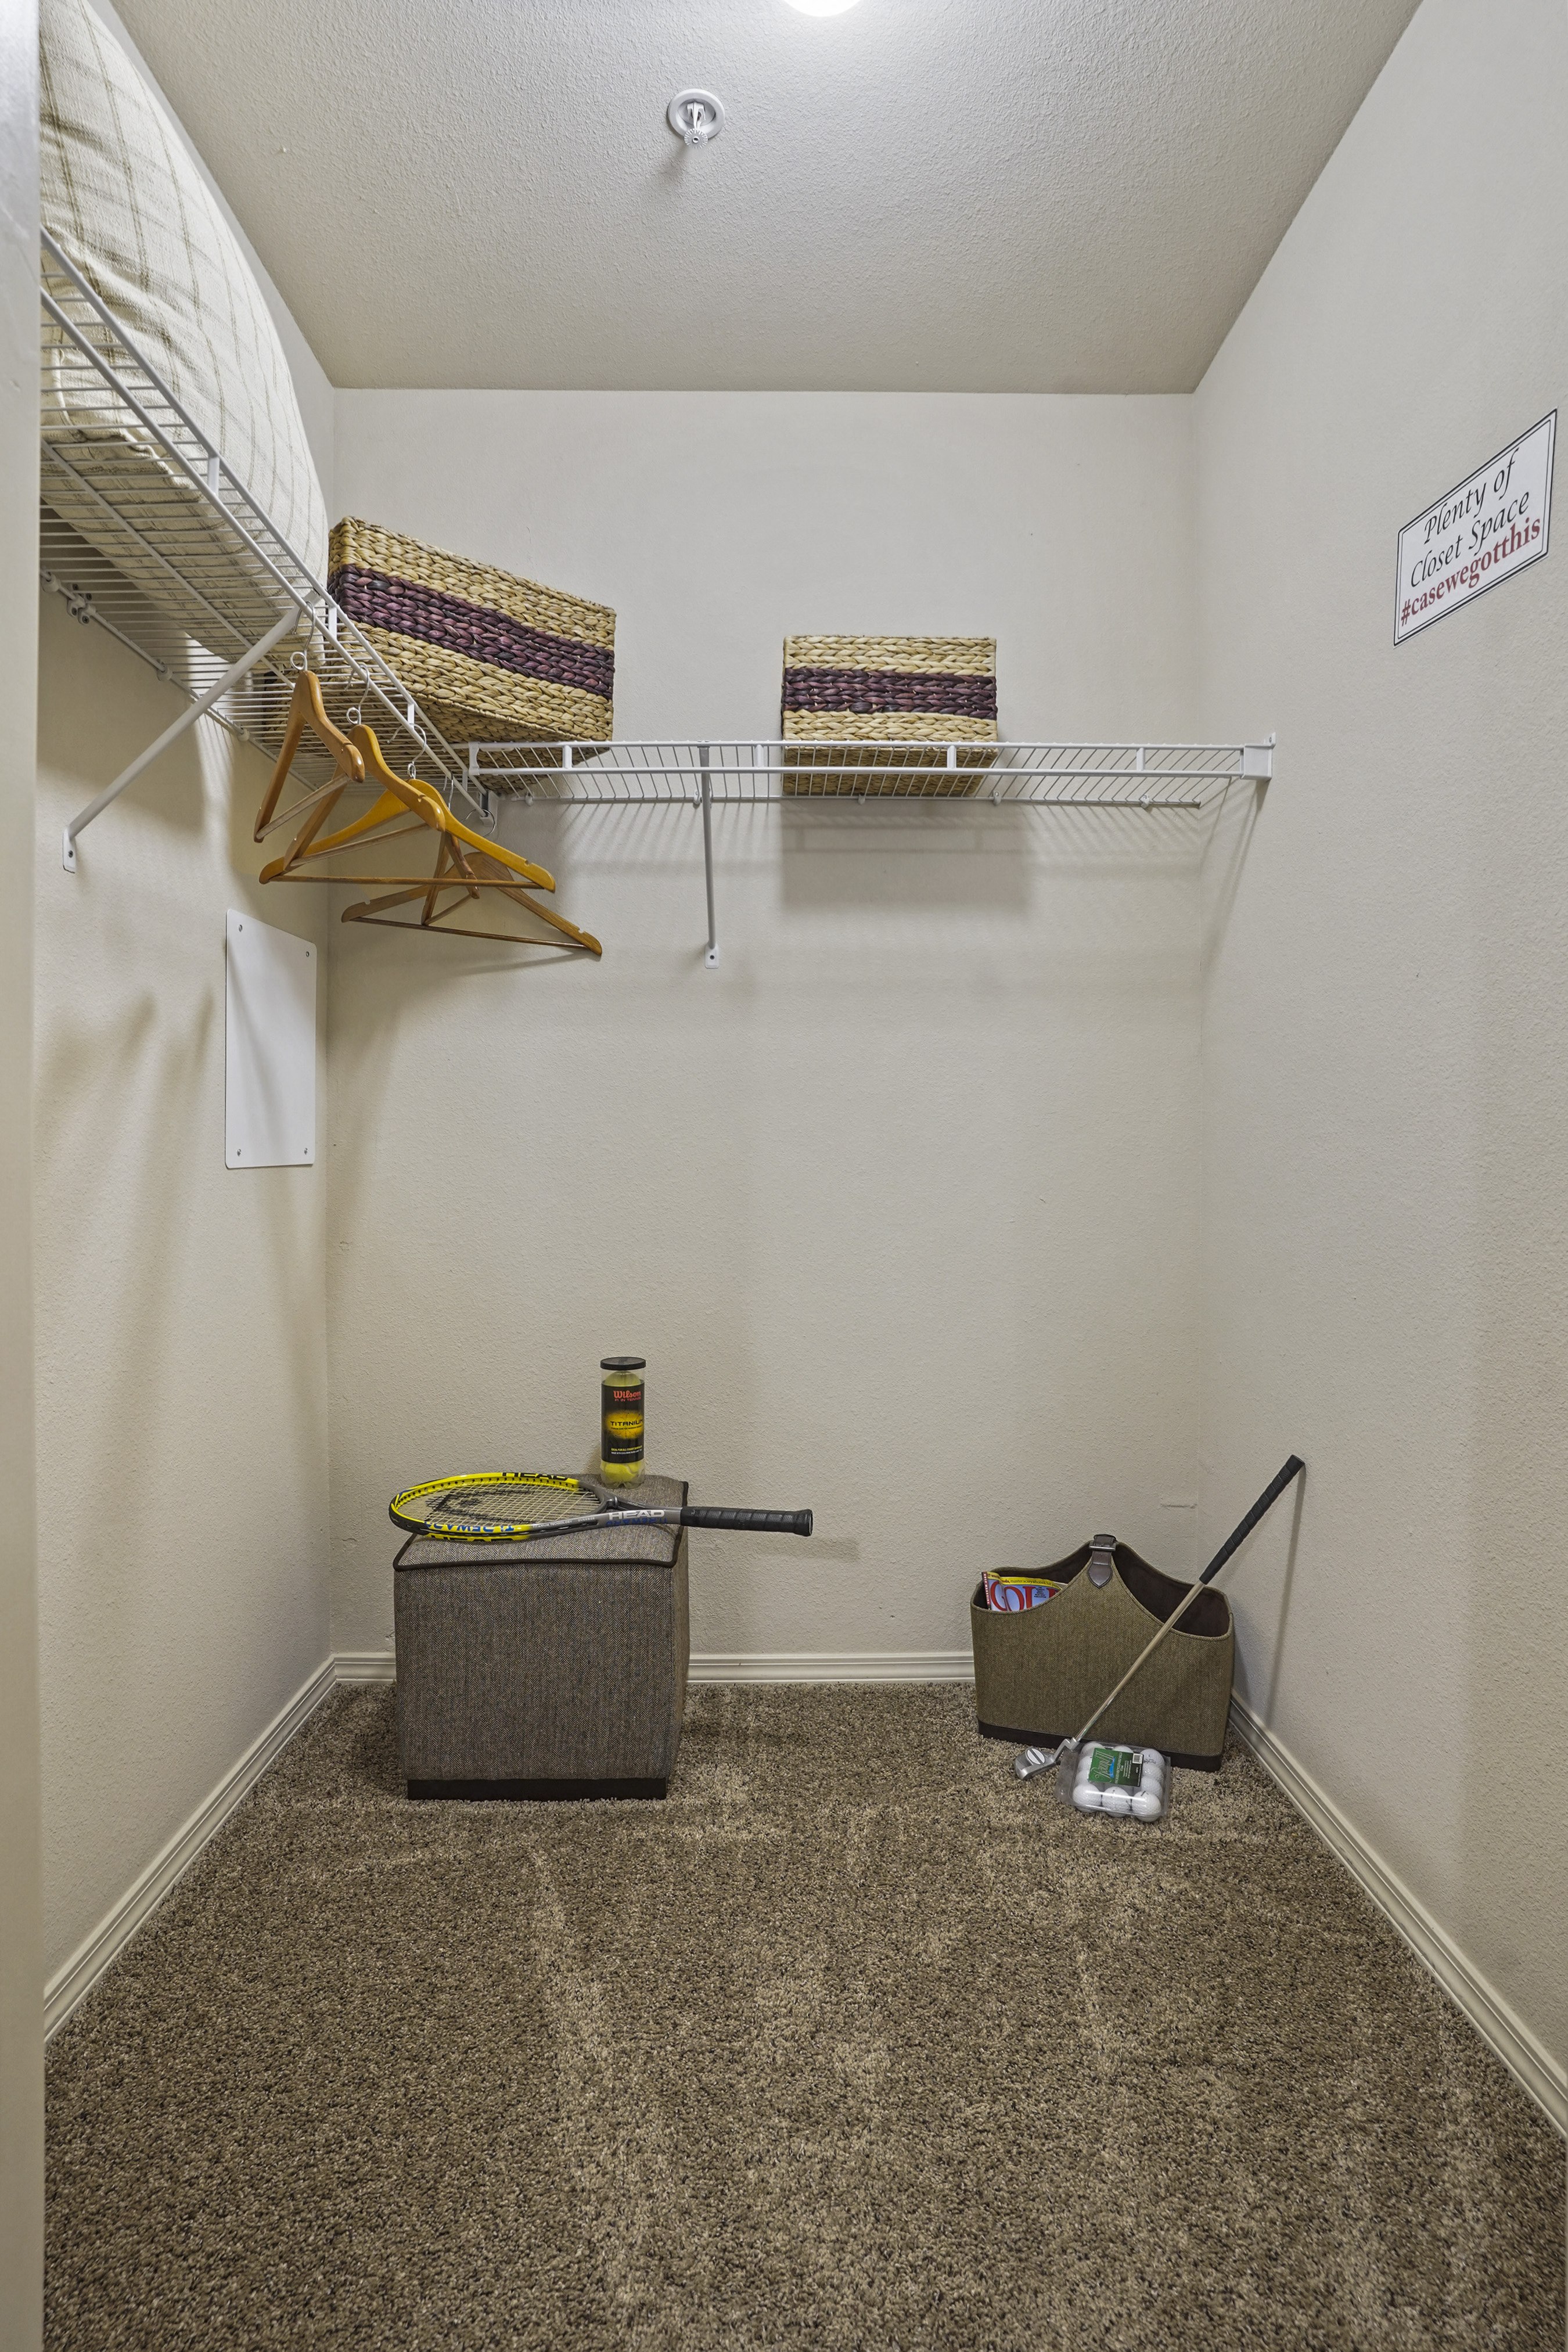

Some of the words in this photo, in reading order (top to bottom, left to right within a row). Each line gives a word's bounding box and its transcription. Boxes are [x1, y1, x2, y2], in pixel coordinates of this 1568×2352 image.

[1411, 534, 1463, 588] Closet
[1468, 491, 1530, 557] Space
[1423, 482, 1487, 545] Plenty
[1493, 447, 1520, 501] of
[1401, 517, 1541, 627] #casewegotthis
[613, 1390, 641, 1398] Wilson
[609, 1509, 665, 1520] HEAD
